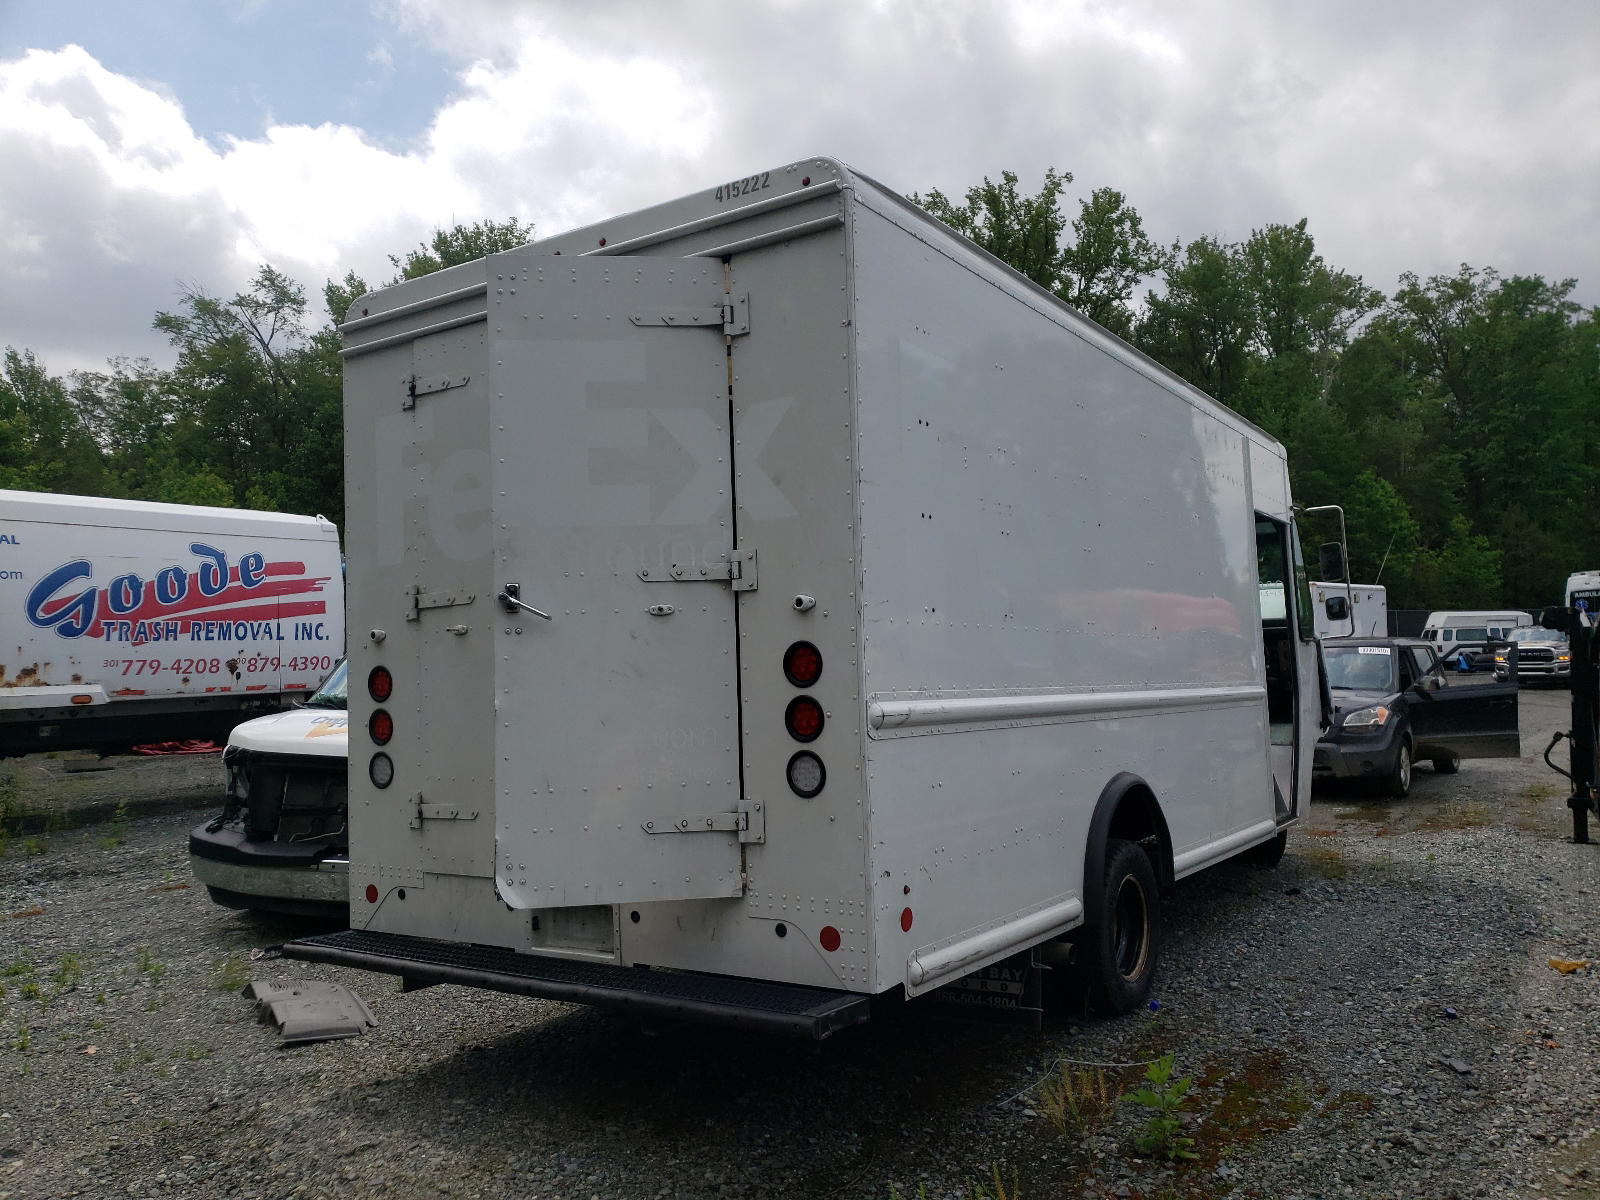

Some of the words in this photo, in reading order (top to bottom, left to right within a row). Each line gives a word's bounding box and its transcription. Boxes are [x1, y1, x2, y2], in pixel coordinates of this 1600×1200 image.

[714, 172, 770, 203] 415222
[25, 542, 267, 639] Goode
[101, 620, 179, 642] TRASH
[190, 621, 285, 641] REMOVAL
[294, 621, 330, 641] INC.
[103, 659, 119, 668] 301
[121, 657, 220, 676] 779-4208
[246, 655, 331, 672] 879-4390
[988, 966, 1023, 981] BAY
